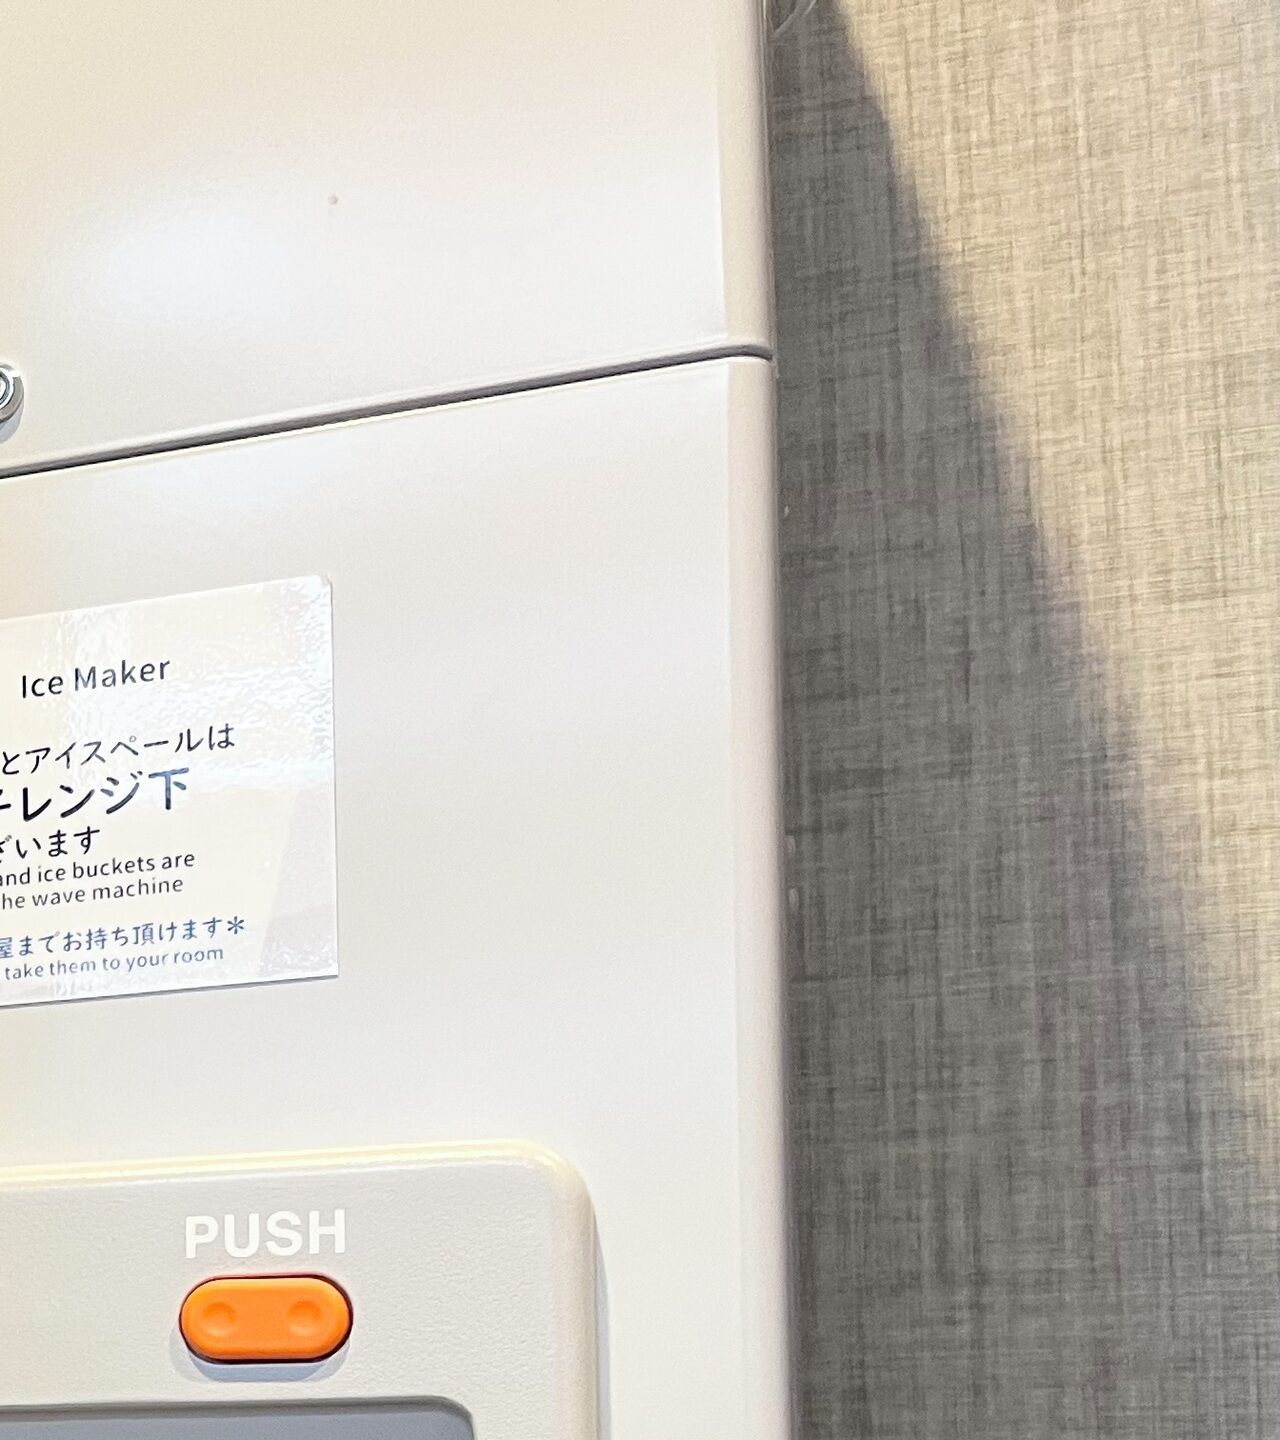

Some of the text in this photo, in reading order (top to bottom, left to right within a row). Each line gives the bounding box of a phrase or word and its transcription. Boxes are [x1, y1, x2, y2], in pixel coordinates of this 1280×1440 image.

[21, 657, 170, 699] Ice Maker
[38, 864, 65, 883] ice
[73, 854, 155, 878] buckets
[161, 852, 195, 869] are
[33, 888, 85, 907] wave
[93, 878, 183, 900] machine
[5, 962, 43, 981] take
[50, 958, 96, 976] them
[102, 957, 120, 972] to
[126, 952, 167, 972] your
[174, 948, 223, 964] room
[185, 1209, 346, 1259] PUSH
